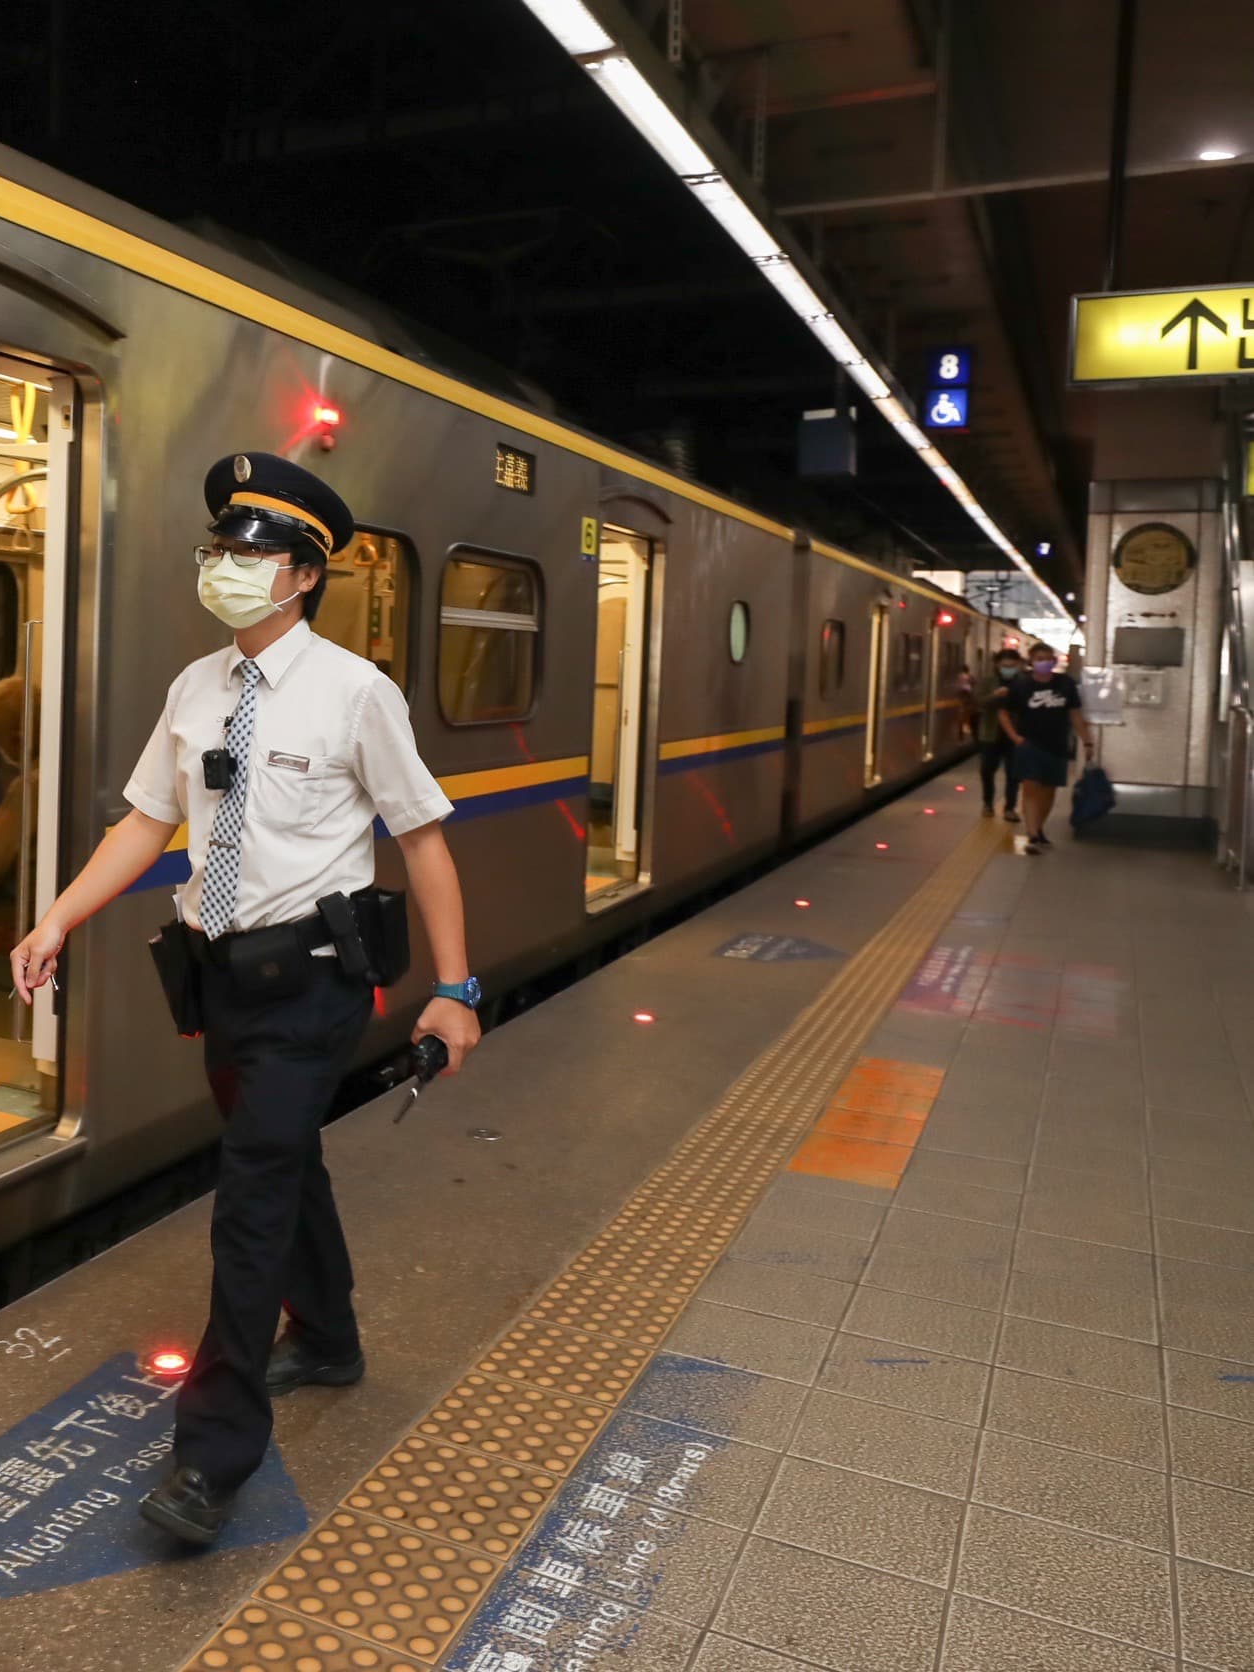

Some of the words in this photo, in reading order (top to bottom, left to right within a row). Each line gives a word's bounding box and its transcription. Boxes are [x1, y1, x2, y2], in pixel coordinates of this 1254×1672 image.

[939, 353, 959, 379] 8
[102, 1423, 176, 1484] Passe
[566, 1602, 629, 1672] aiting
[607, 1540, 657, 1591] Line
